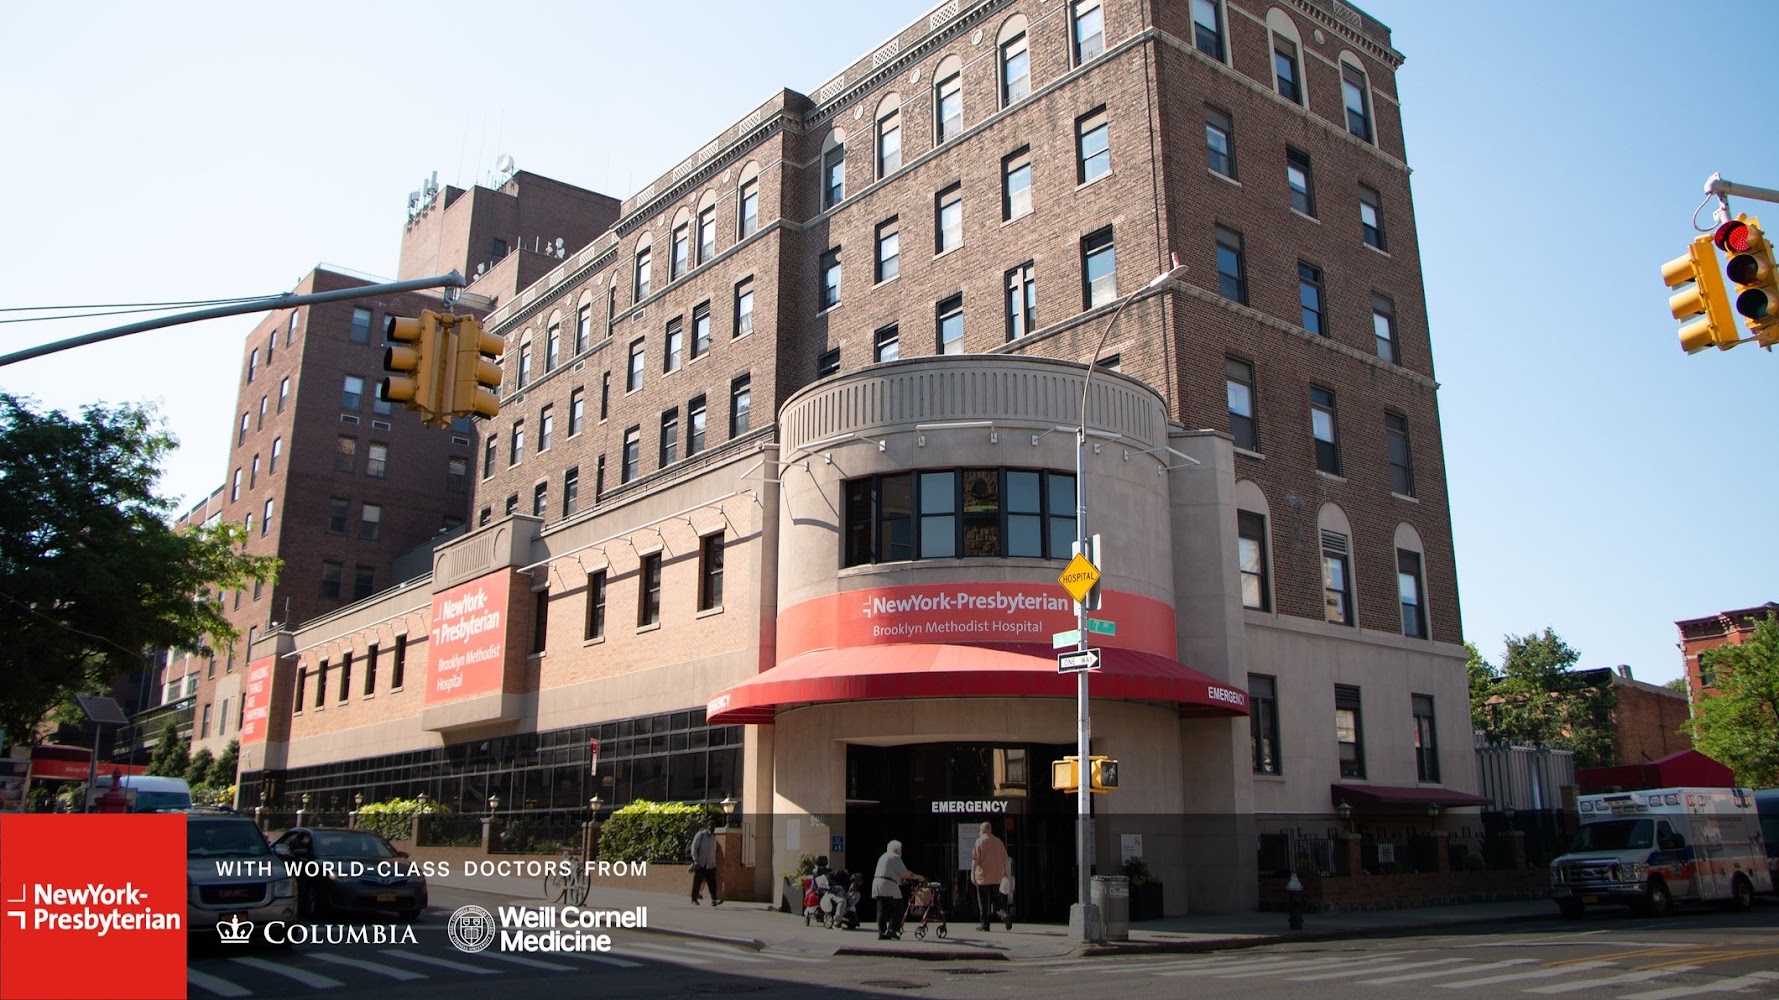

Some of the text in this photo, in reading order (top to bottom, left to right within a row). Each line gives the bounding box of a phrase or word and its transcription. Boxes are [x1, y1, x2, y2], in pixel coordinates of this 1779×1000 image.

[1063, 571, 1094, 584] HOSPITAL
[443, 587, 488, 620] NewYork-
[873, 591, 1068, 614] NewYork-Presbyterian
[441, 609, 499, 644] Presbyterian
[873, 620, 1043, 637] Brooklyn Methodist Hospital
[1094, 620, 1100, 632] 7
[438, 643, 500, 672] Brooklyn Methodist
[1063, 655, 1094, 667] ONE WAY
[437, 671, 463, 692] Hospital
[1208, 686, 1245, 706] EMERGENCY
[932, 801, 1007, 813] EMERGENCY
